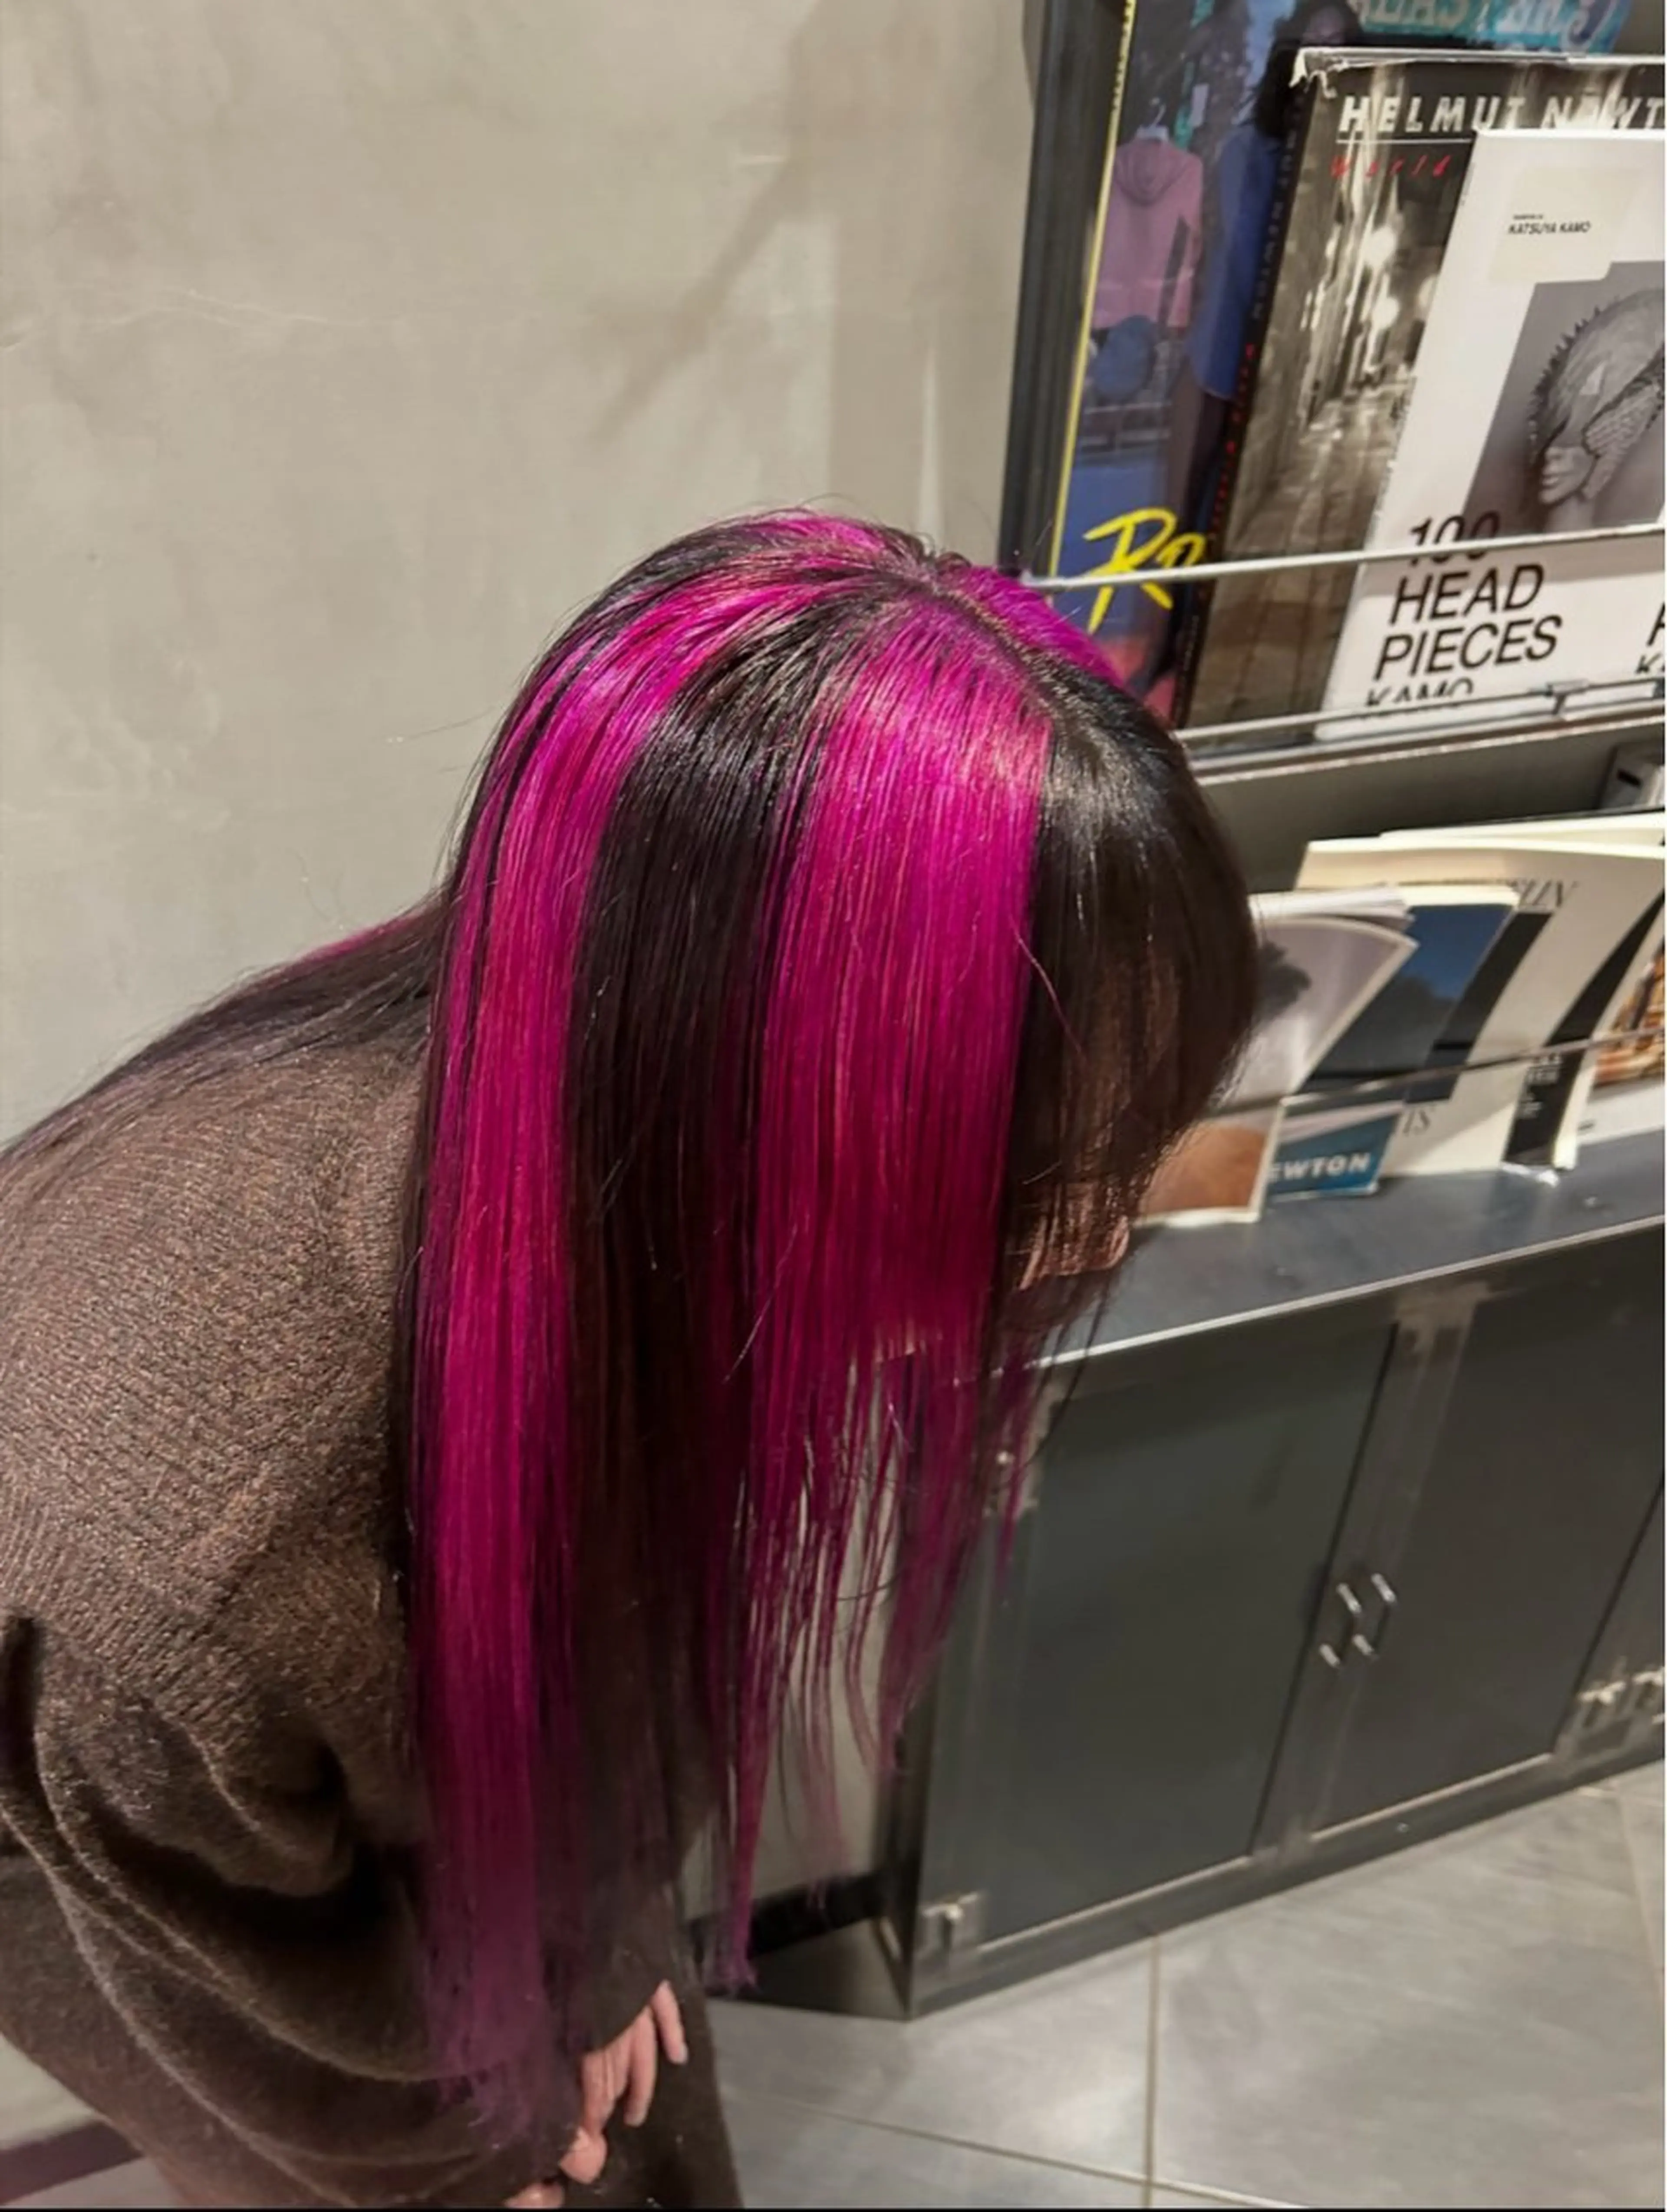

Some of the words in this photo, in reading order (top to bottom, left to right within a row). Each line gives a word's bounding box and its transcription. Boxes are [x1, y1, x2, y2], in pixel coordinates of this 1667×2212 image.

[1338, 95, 1525, 132] HELMUT
[1389, 564, 1544, 625] HEAD
[1373, 615, 1562, 681] PIECES
